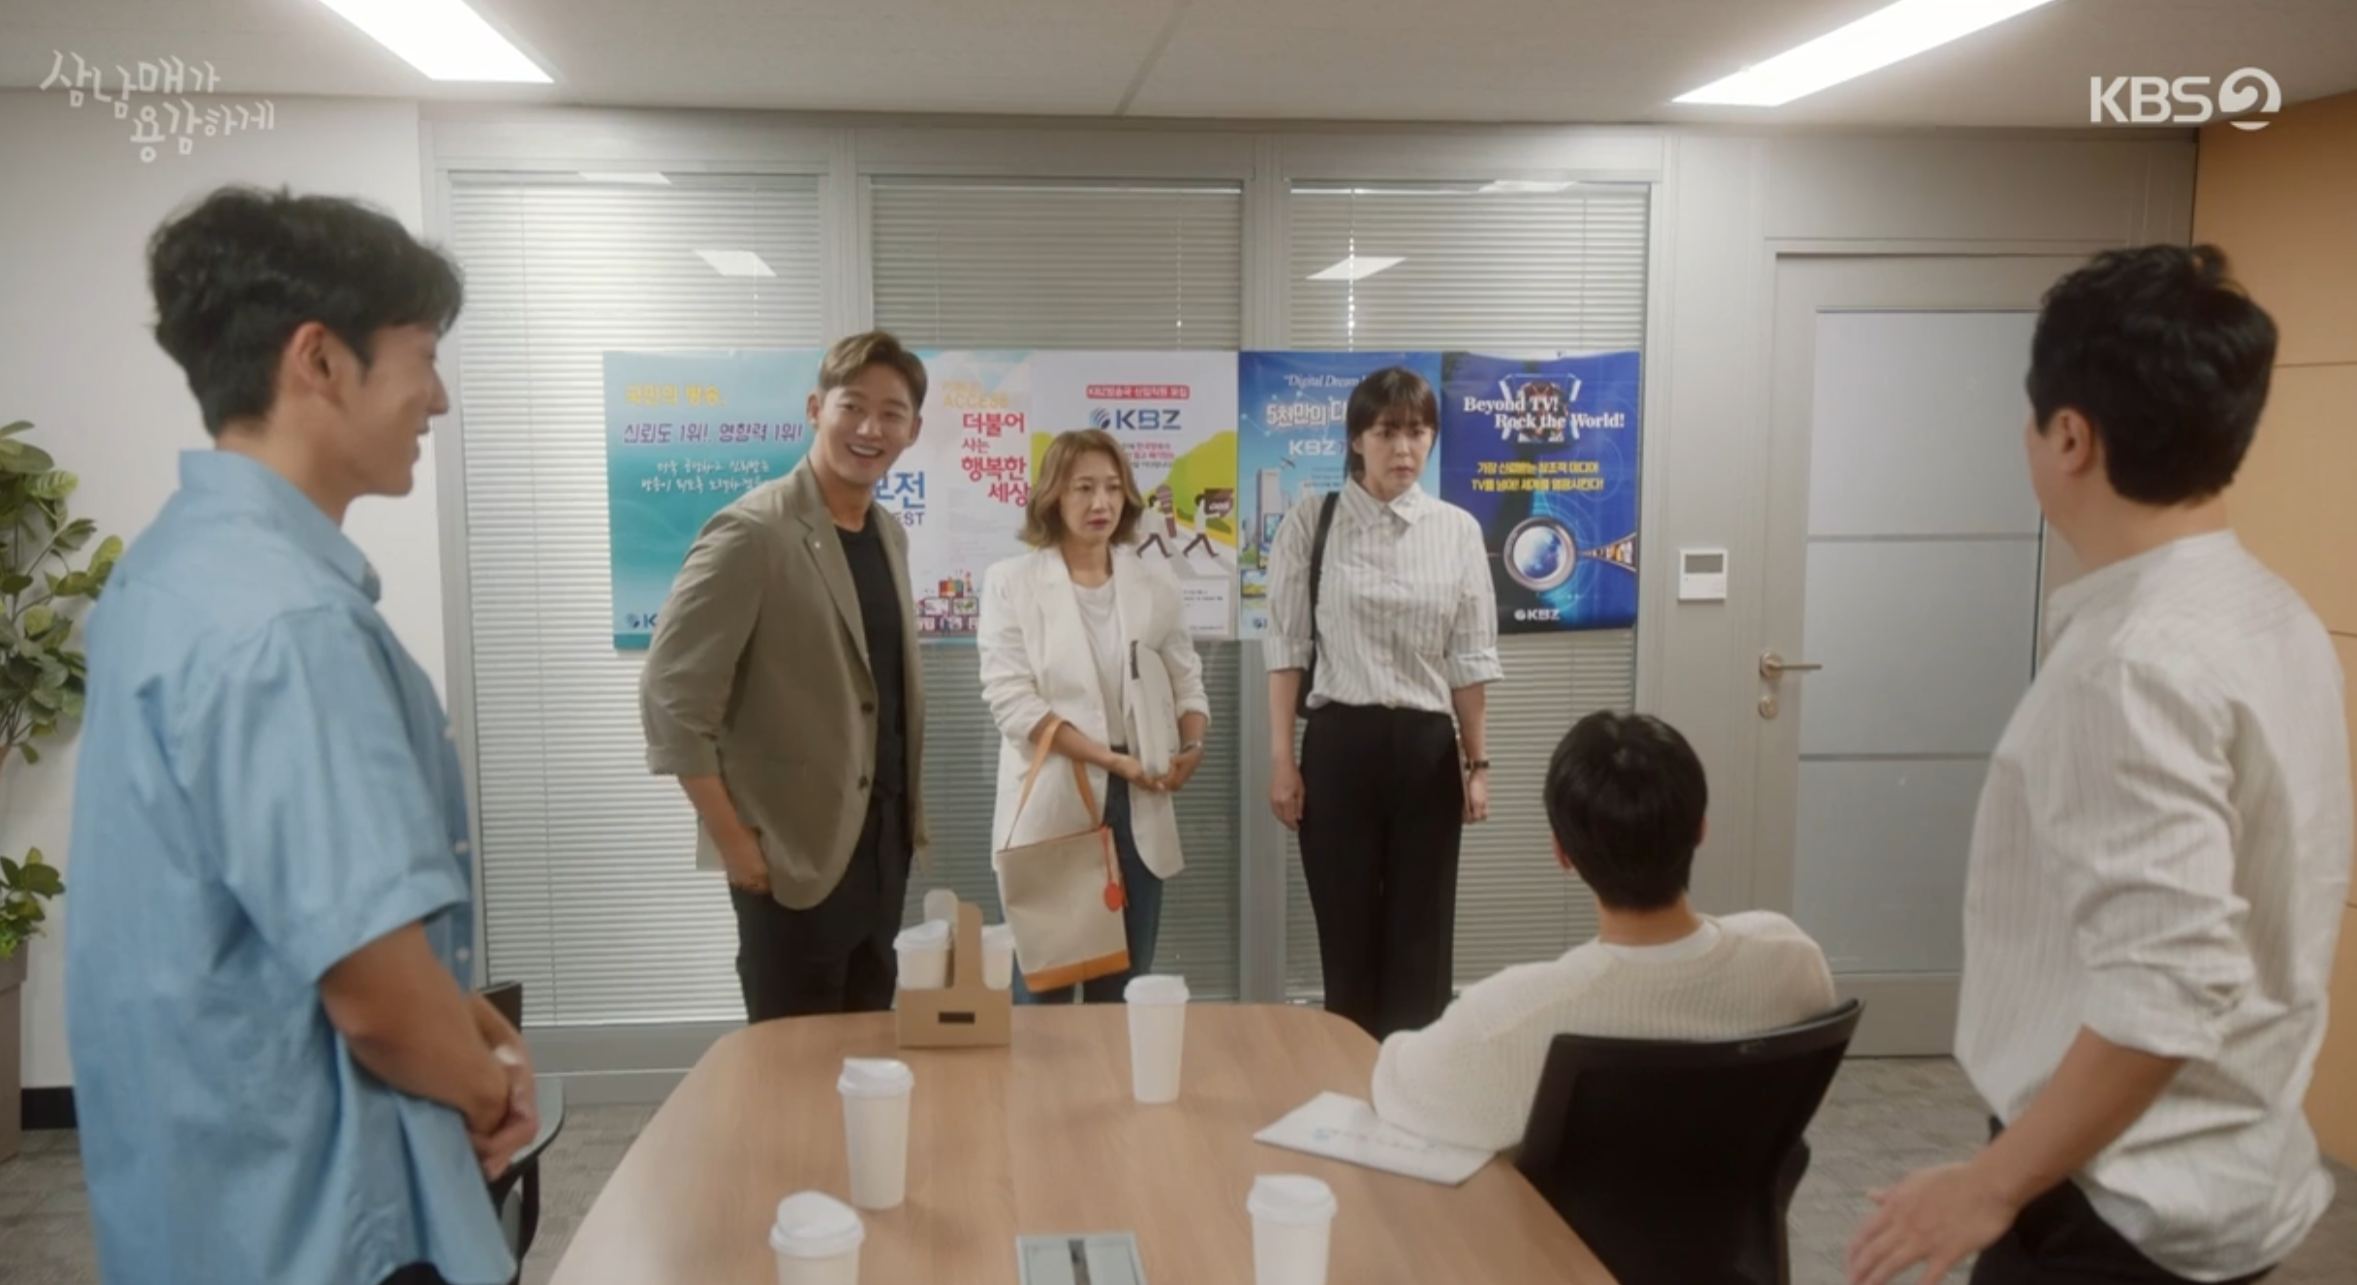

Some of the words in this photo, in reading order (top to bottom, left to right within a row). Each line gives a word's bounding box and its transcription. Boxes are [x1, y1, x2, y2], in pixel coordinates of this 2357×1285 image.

[1266, 402, 1327, 428] 5천만의
[1463, 397, 1526, 414] Beyond
[1529, 397, 1559, 412] TV!
[962, 412, 1025, 437] 더불어
[1116, 408, 1182, 431] KBZ
[1494, 413, 1537, 430] Rock
[1539, 413, 1567, 429] the
[1570, 413, 1626, 428] World!
[623, 423, 673, 444] 신뢰도
[719, 423, 768, 442] 영향력
[774, 423, 804, 442] 1위!
[961, 438, 991, 454] 사는
[1289, 440, 1337, 456] KBZ
[961, 456, 1027, 482] 행복한
[988, 482, 1031, 507] 세상
[1526, 608, 1561, 621] KBZ
